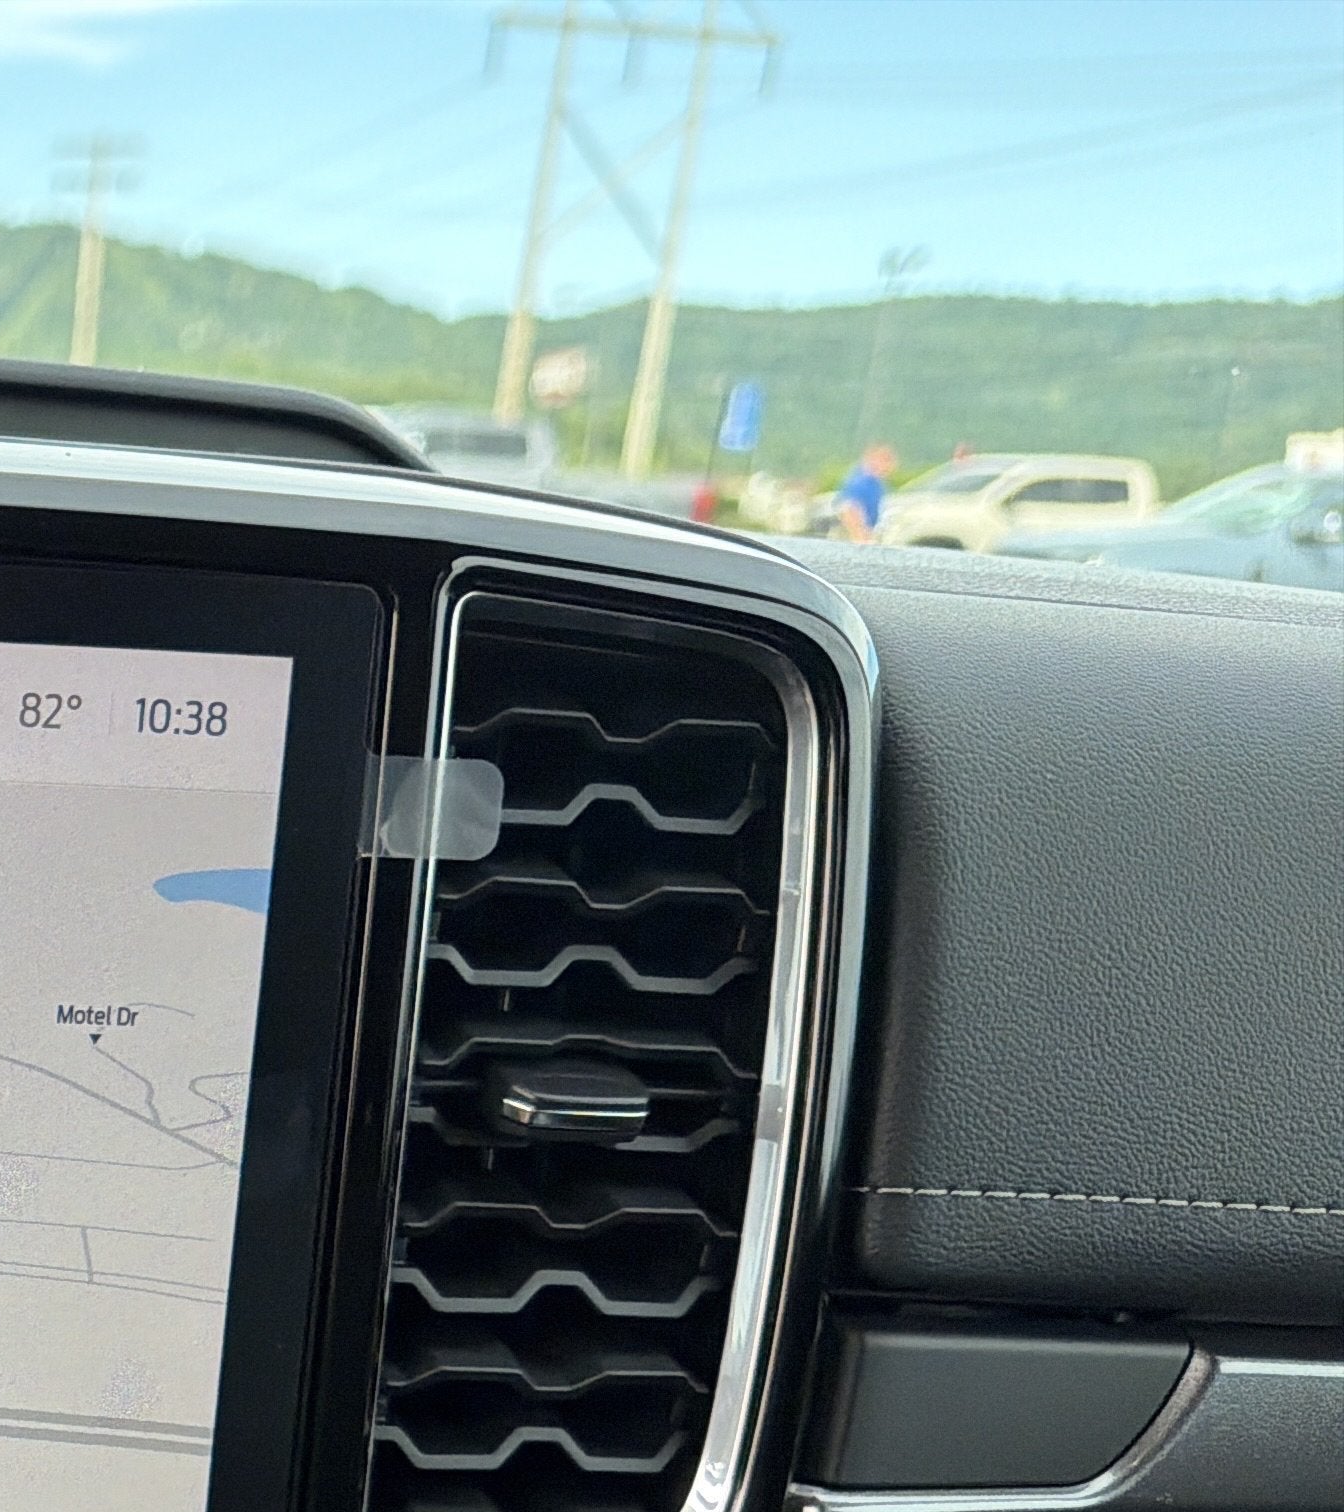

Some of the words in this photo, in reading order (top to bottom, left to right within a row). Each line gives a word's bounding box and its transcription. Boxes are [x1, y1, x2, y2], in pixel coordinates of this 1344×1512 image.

[135, 697, 229, 737] 10:38
[56, 1005, 110, 1026] Motel
[114, 1006, 139, 1027] Dr
